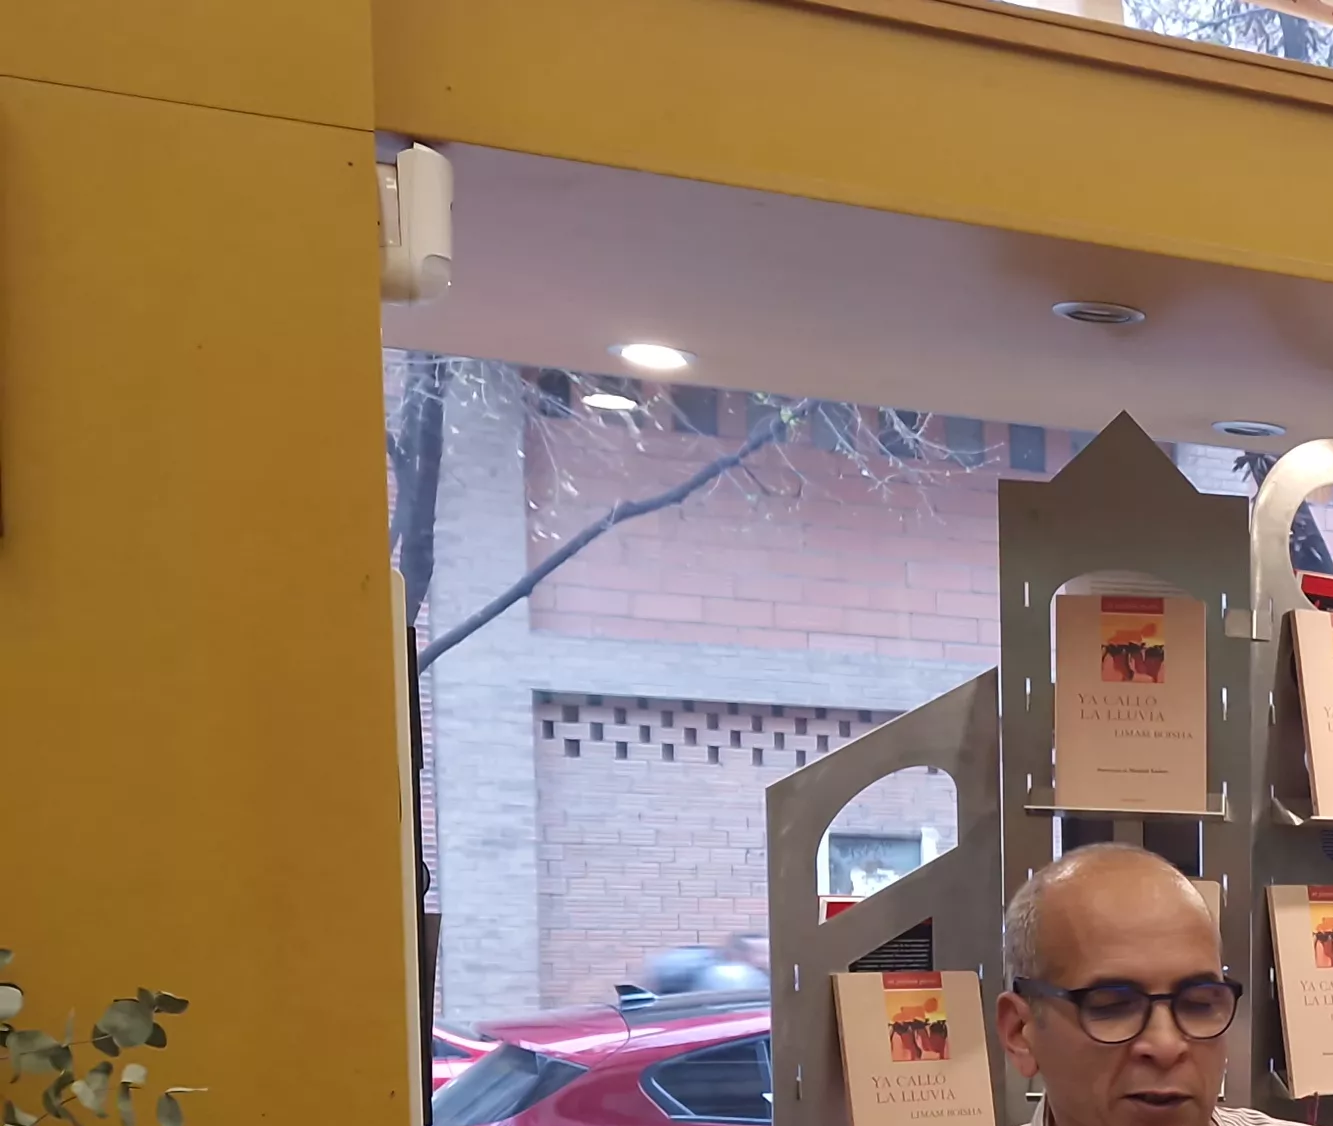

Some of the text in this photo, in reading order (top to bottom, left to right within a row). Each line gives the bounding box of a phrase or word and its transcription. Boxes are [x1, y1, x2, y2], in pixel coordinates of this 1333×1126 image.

[1300, 979, 1316, 992] YA
[1303, 993, 1320, 1006] LA
[871, 1072, 946, 1089] YA CALLÓ
[876, 1090, 956, 1104] LA LLUVIA
